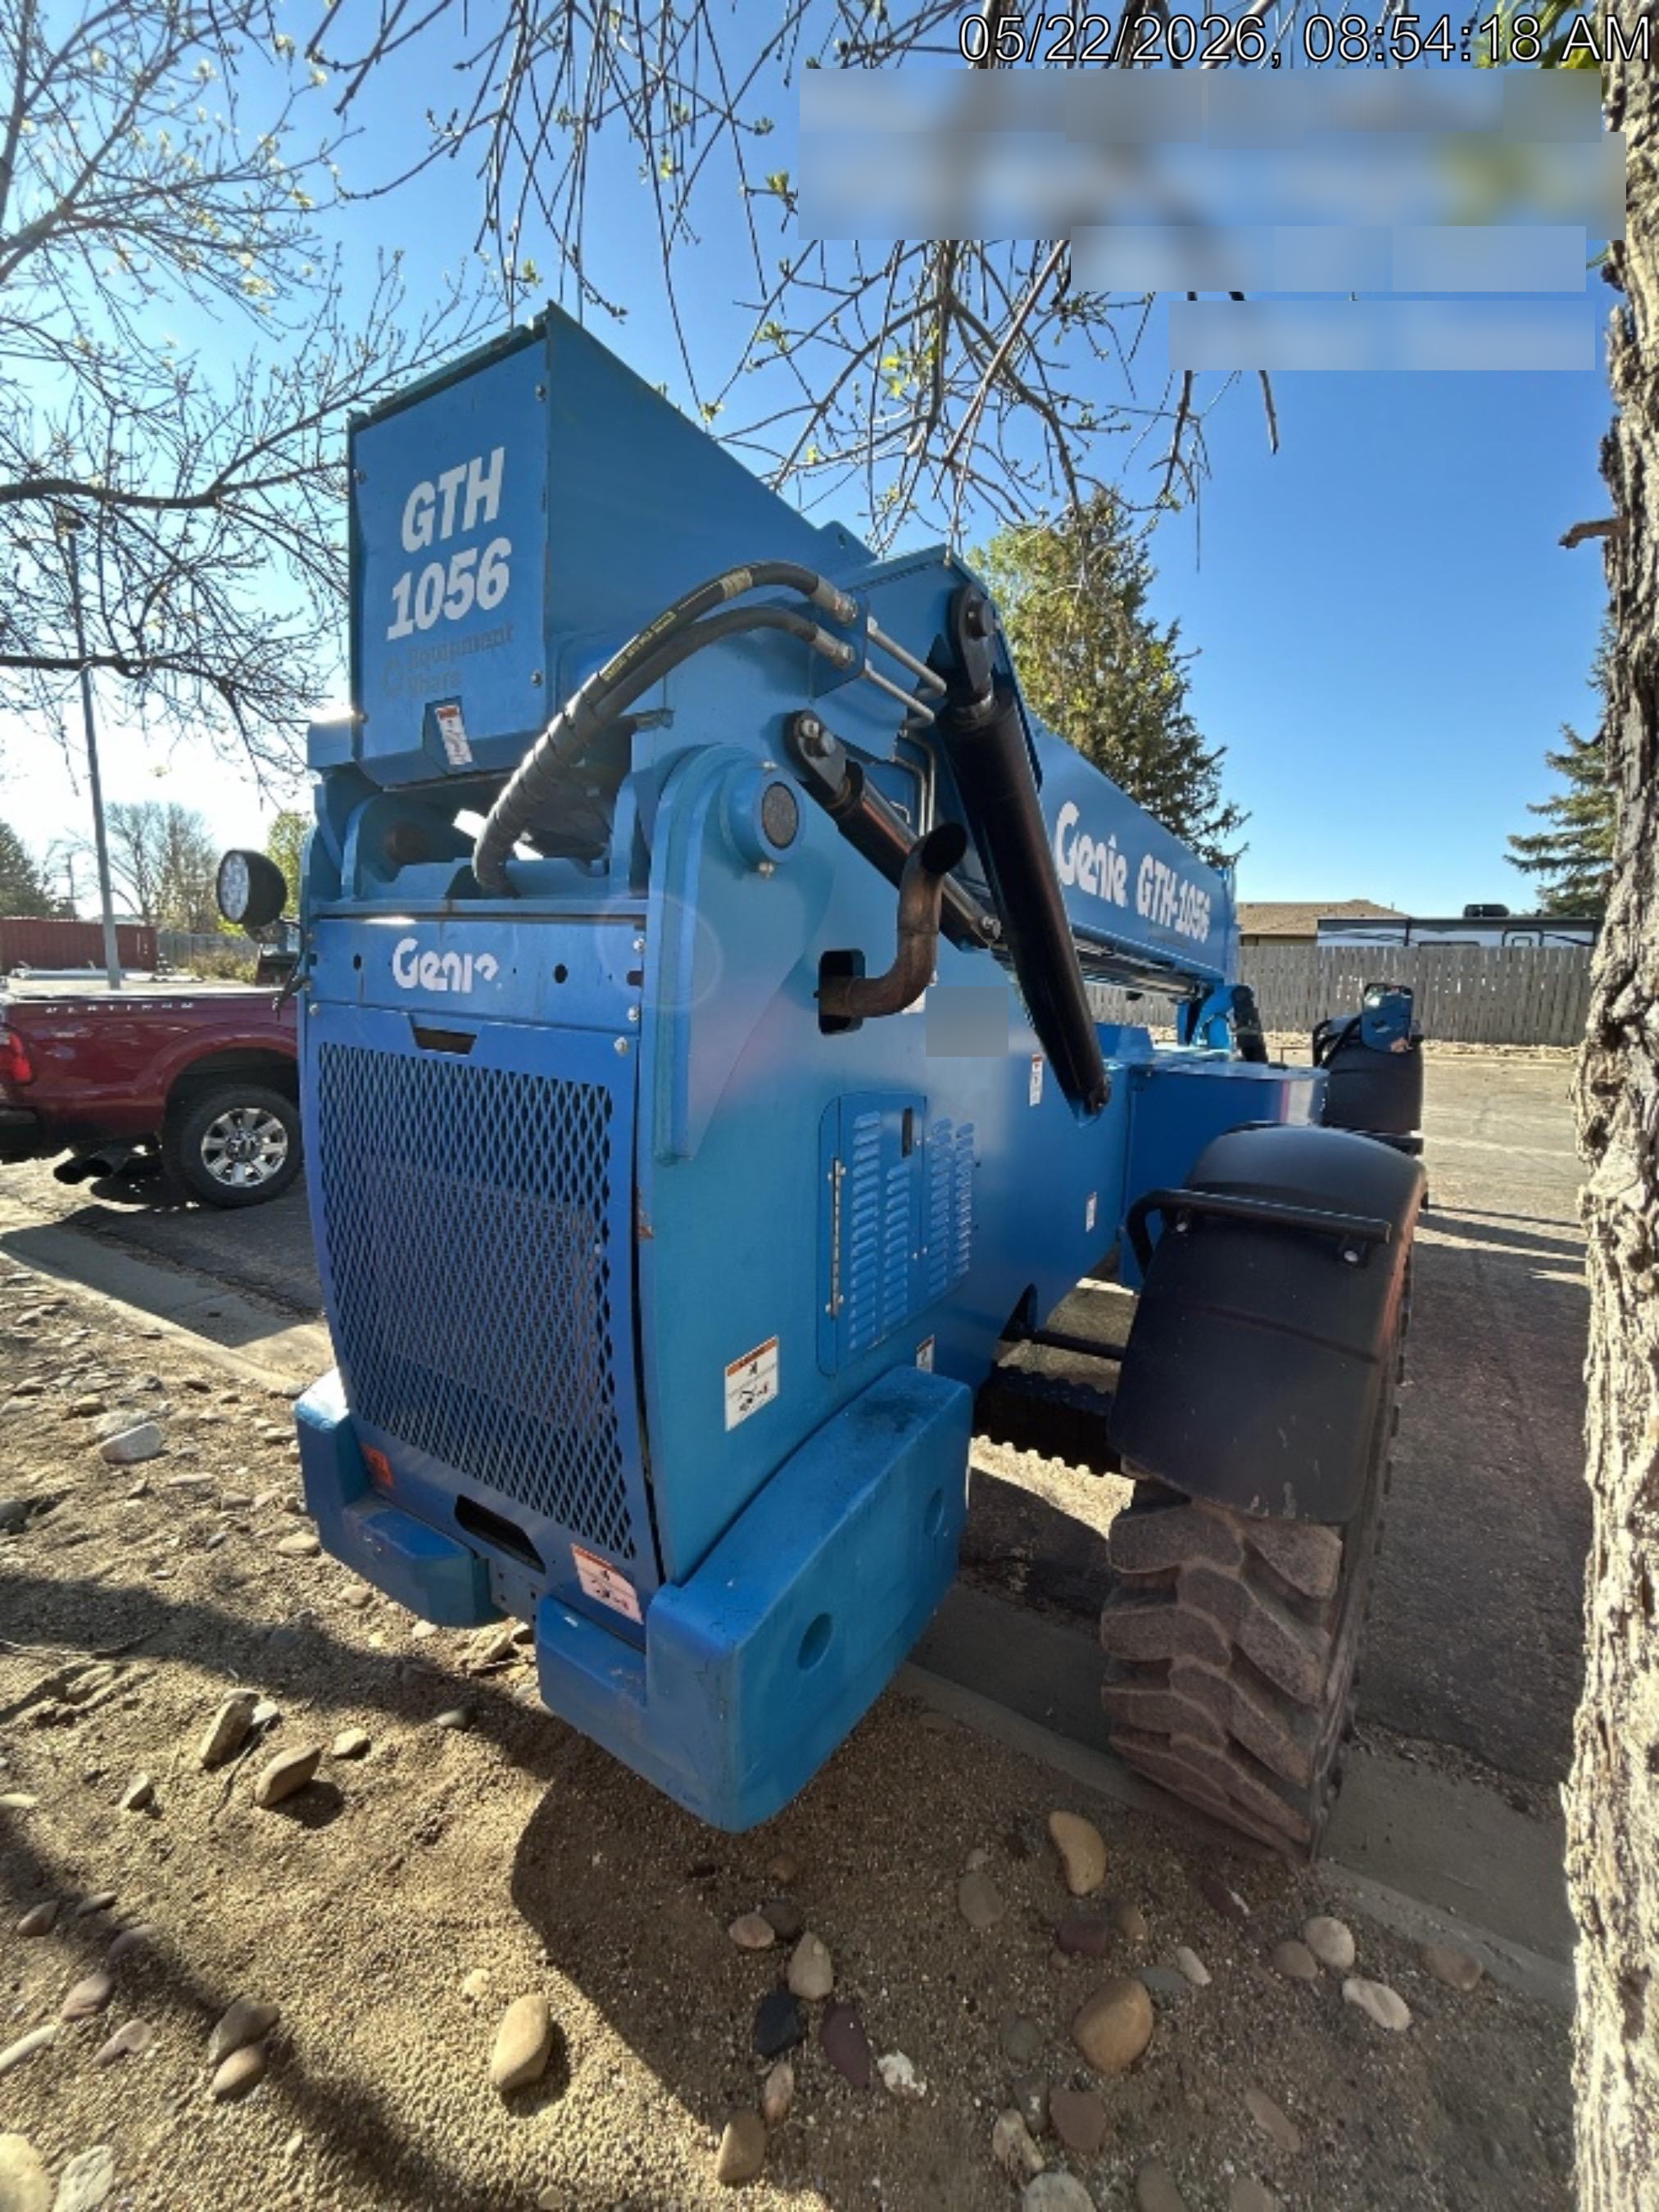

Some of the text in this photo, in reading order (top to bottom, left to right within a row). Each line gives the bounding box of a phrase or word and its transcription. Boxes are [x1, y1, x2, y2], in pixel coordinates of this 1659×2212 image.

[401, 447, 505, 553] GTH
[387, 537, 512, 641] 1056
[1055, 801, 1210, 943] Genie GTH-1056
